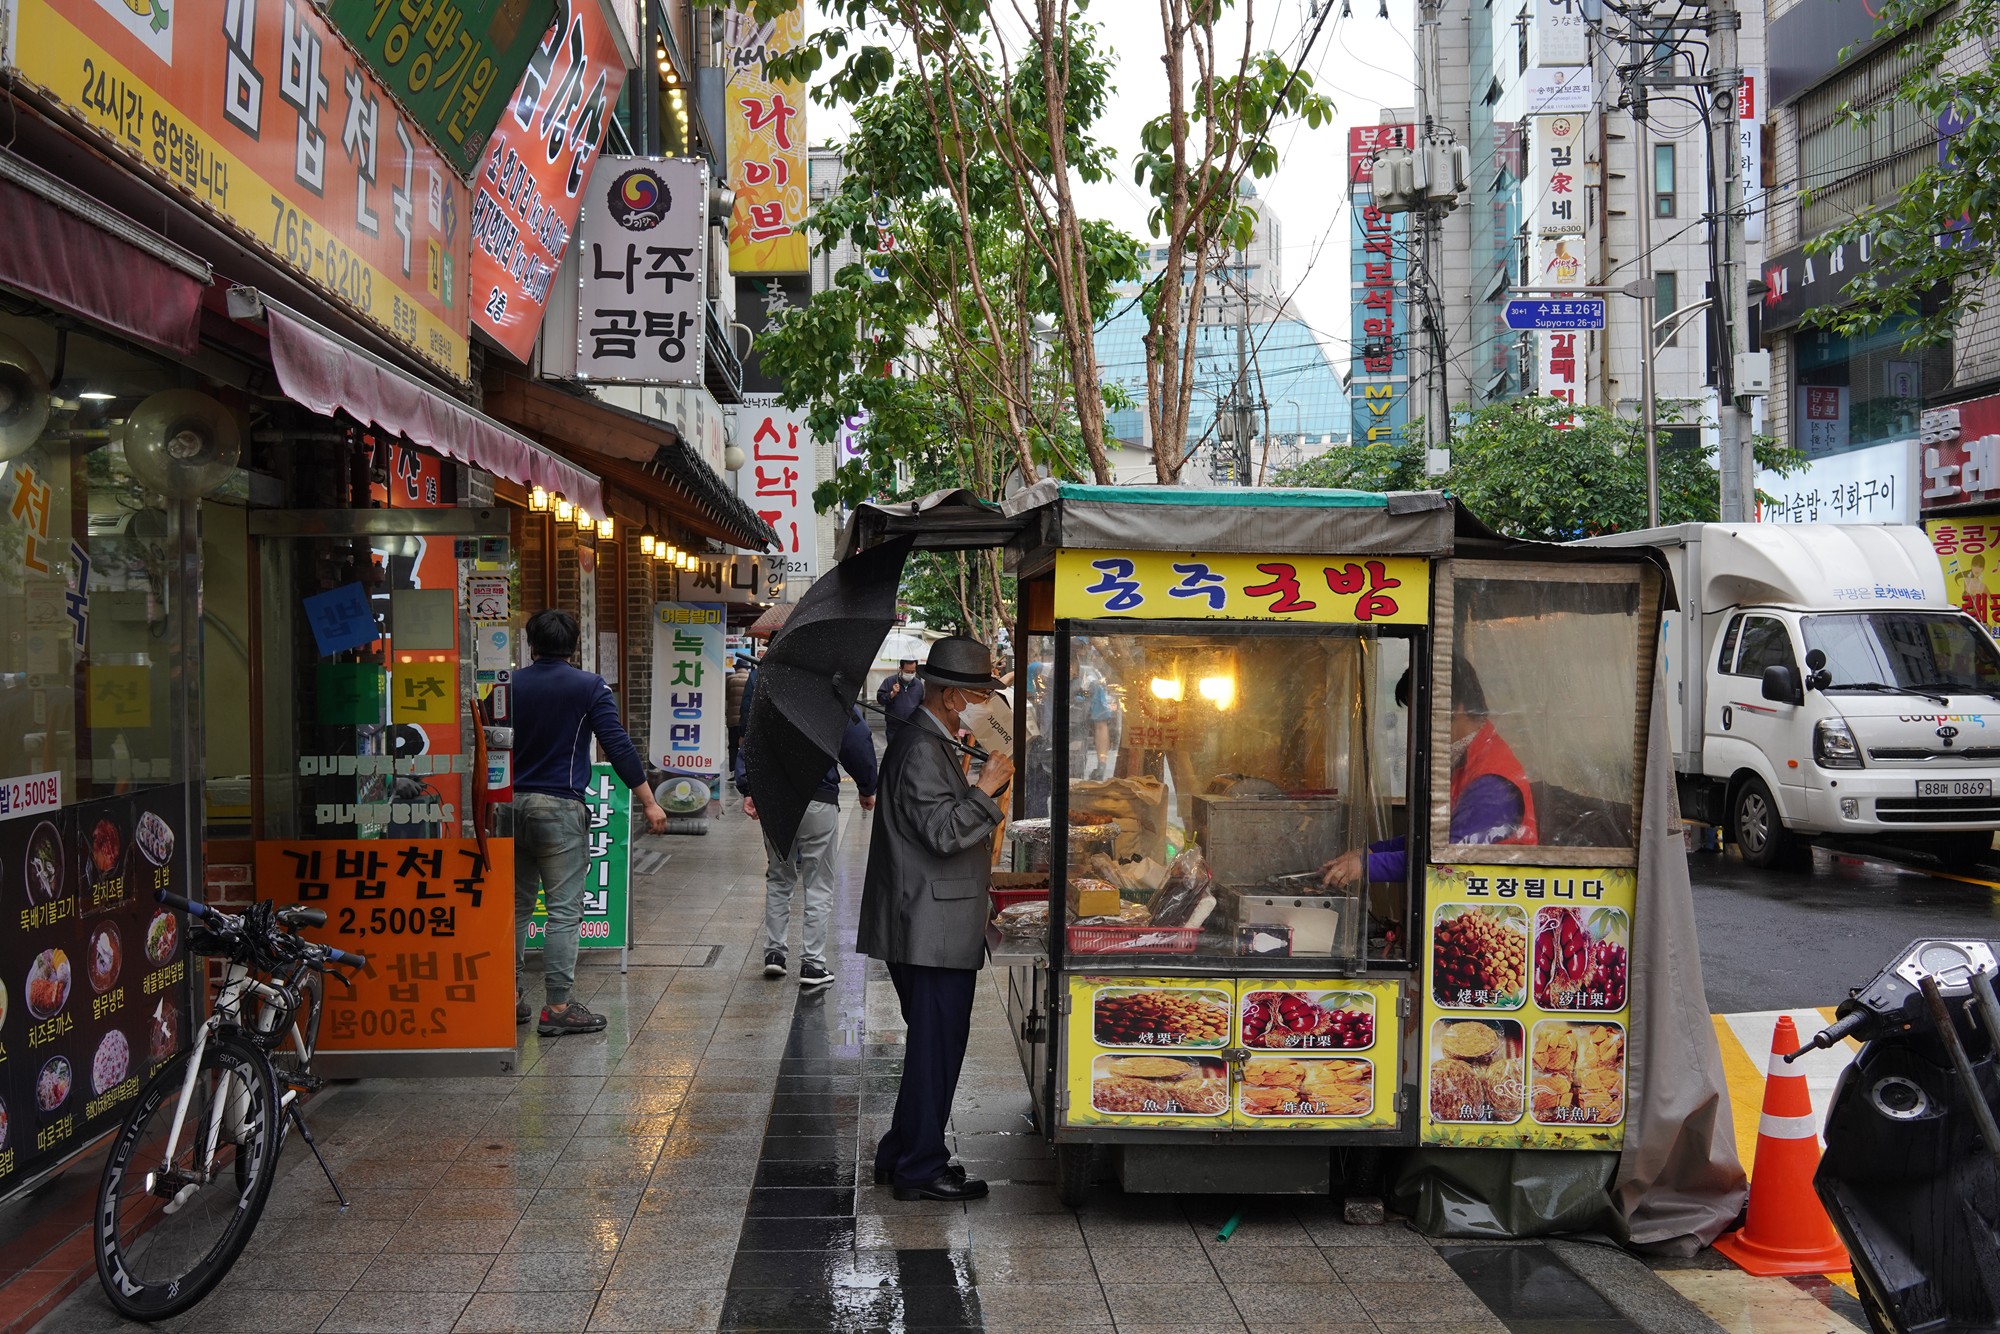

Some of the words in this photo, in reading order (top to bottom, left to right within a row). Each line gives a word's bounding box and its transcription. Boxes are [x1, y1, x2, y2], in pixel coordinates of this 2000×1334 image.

[1551, 16, 1583, 27] うなぎ
[82, 58, 144, 147] 24시간
[151, 107, 229, 210] 영업합니다
[223, 0, 415, 278] 김밥천국
[739, 93, 797, 243] 라이브
[1550, 147, 1573, 220] 김家네
[473, 187, 519, 272] 돼지한마리
[527, 191, 544, 236] 1kg
[1543, 225, 1582, 234] 742-6300
[270, 193, 373, 315] 765-6203
[510, 241, 527, 284] 1kg
[592, 242, 695, 296] 나주
[485, 286, 507, 324] 2층
[1535, 318, 1575, 328] Supyo-ro
[1577, 318, 1602, 328] 26-gil
[1537, 303, 1602, 317] 수표로26길
[589, 309, 694, 363] 곰탕
[743, 398, 809, 409] 산낙지요문
[753, 417, 799, 553] 산낙지
[1923, 434, 2000, 499] 노래
[1763, 488, 1821, 523] 가마솥밥
[1831, 474, 1895, 519] 직화구이
[10, 466, 90, 647] 천국
[767, 558, 786, 600] 라이브
[1085, 558, 1227, 612] 공주
[1243, 560, 1402, 621] 군밤
[1833, 588, 1871, 600] 쿠팡은
[1874, 584, 1926, 601] 로켓배송!
[660, 608, 721, 624] 여름별미
[669, 628, 705, 751] 녹차냉면
[987, 715, 1012, 744] upang
[1939, 727, 1956, 736] KIA
[663, 754, 712, 768] 6,000원
[13, 776, 57, 811] 2,500원
[1925, 782, 1949, 795] 88머
[1955, 782, 1985, 795] 0869
[92, 876, 124, 905] 갈치조림
[154, 866, 170, 889] 김밥
[282, 846, 485, 907] 김밥천국
[1465, 877, 1605, 900] 포장됩니다
[20, 895, 76, 932] 뚝배기불고기
[338, 906, 456, 938] 2,500원
[143, 960, 185, 995] 해물철판덮밥
[92, 986, 125, 1020] 열무냉면
[28, 1012, 74, 1049] 치즈돈까스
[219, 1052, 241, 1067] SIXTY
[116, 1089, 161, 1160] BIKE
[1142, 1099, 1183, 1113] 魚片
[1283, 1100, 1329, 1114] 炸魚片
[1459, 1105, 1494, 1120] 魚片
[1555, 1105, 1600, 1122] 炸魚片
[37, 1113, 73, 1152] 따로국밥
[235, 1061, 265, 1210] ALTON
